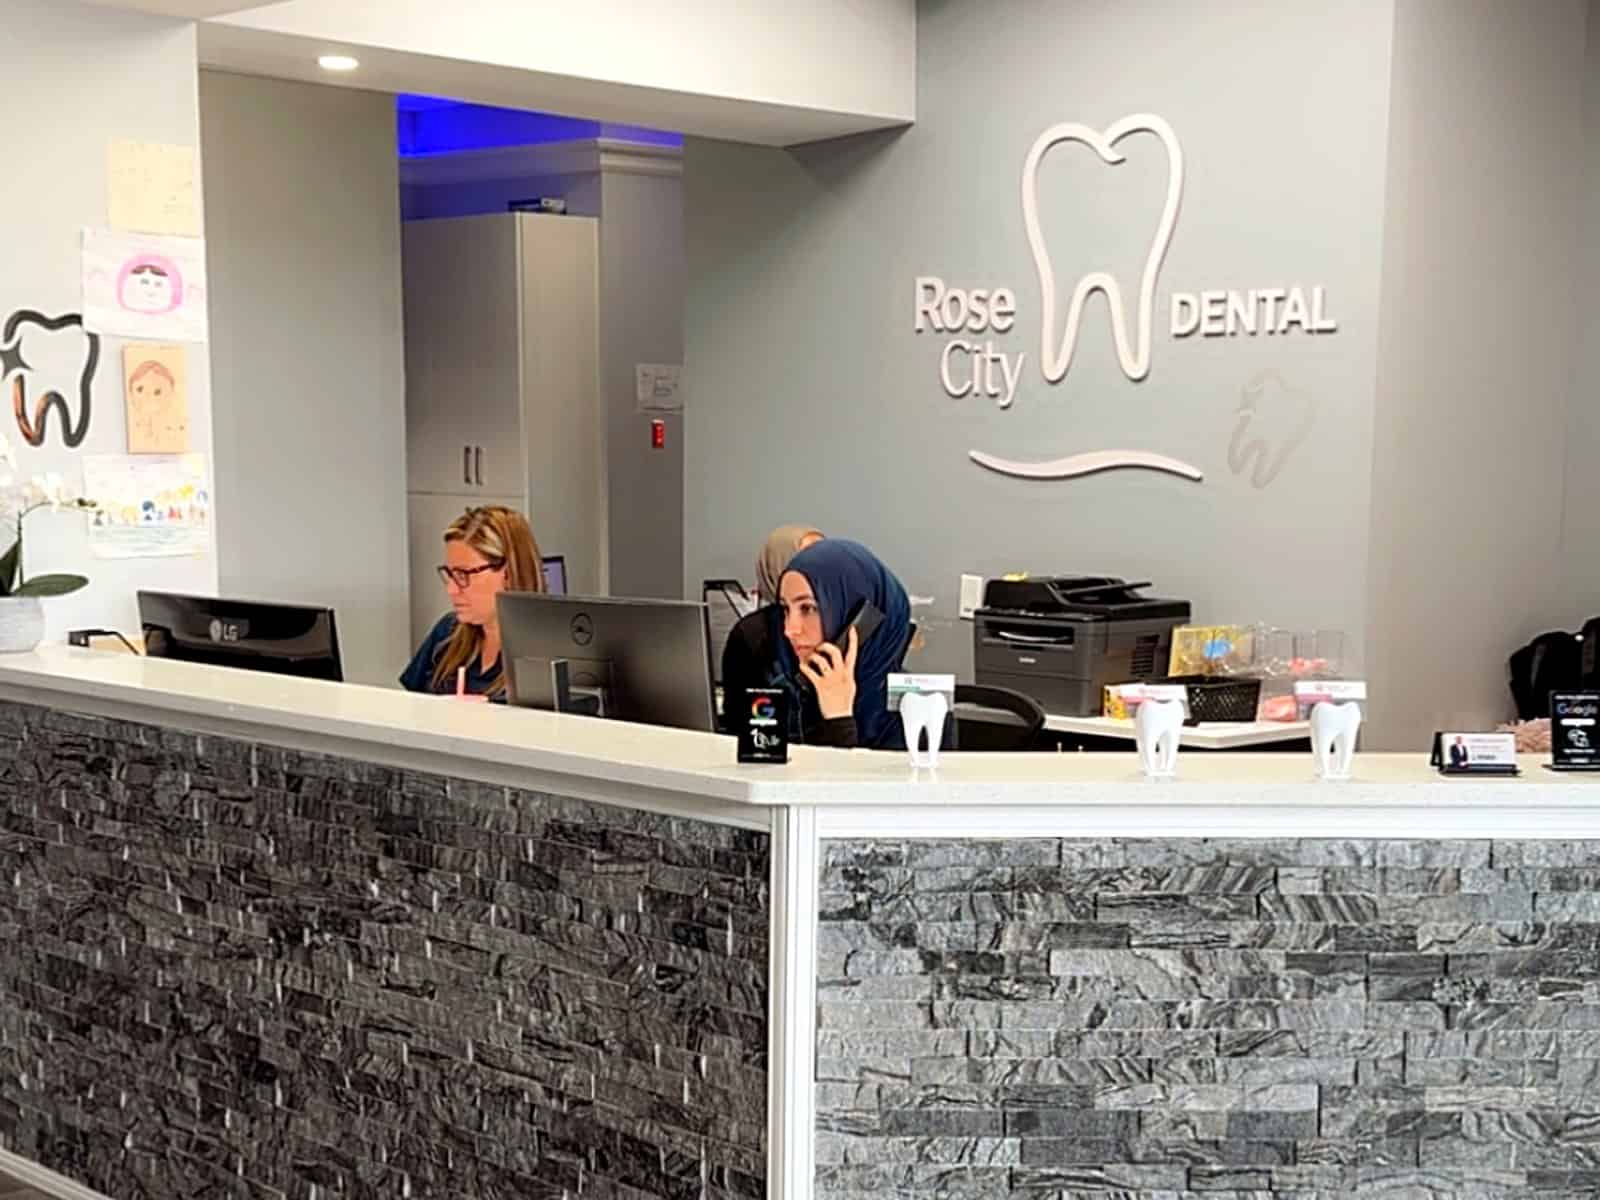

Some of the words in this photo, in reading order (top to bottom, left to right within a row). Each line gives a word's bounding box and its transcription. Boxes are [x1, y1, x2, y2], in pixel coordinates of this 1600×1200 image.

[914, 276, 1016, 334] Rose
[1170, 286, 1338, 338] DENTAL
[940, 340, 1025, 410] City
[1556, 702, 1598, 717] Google
